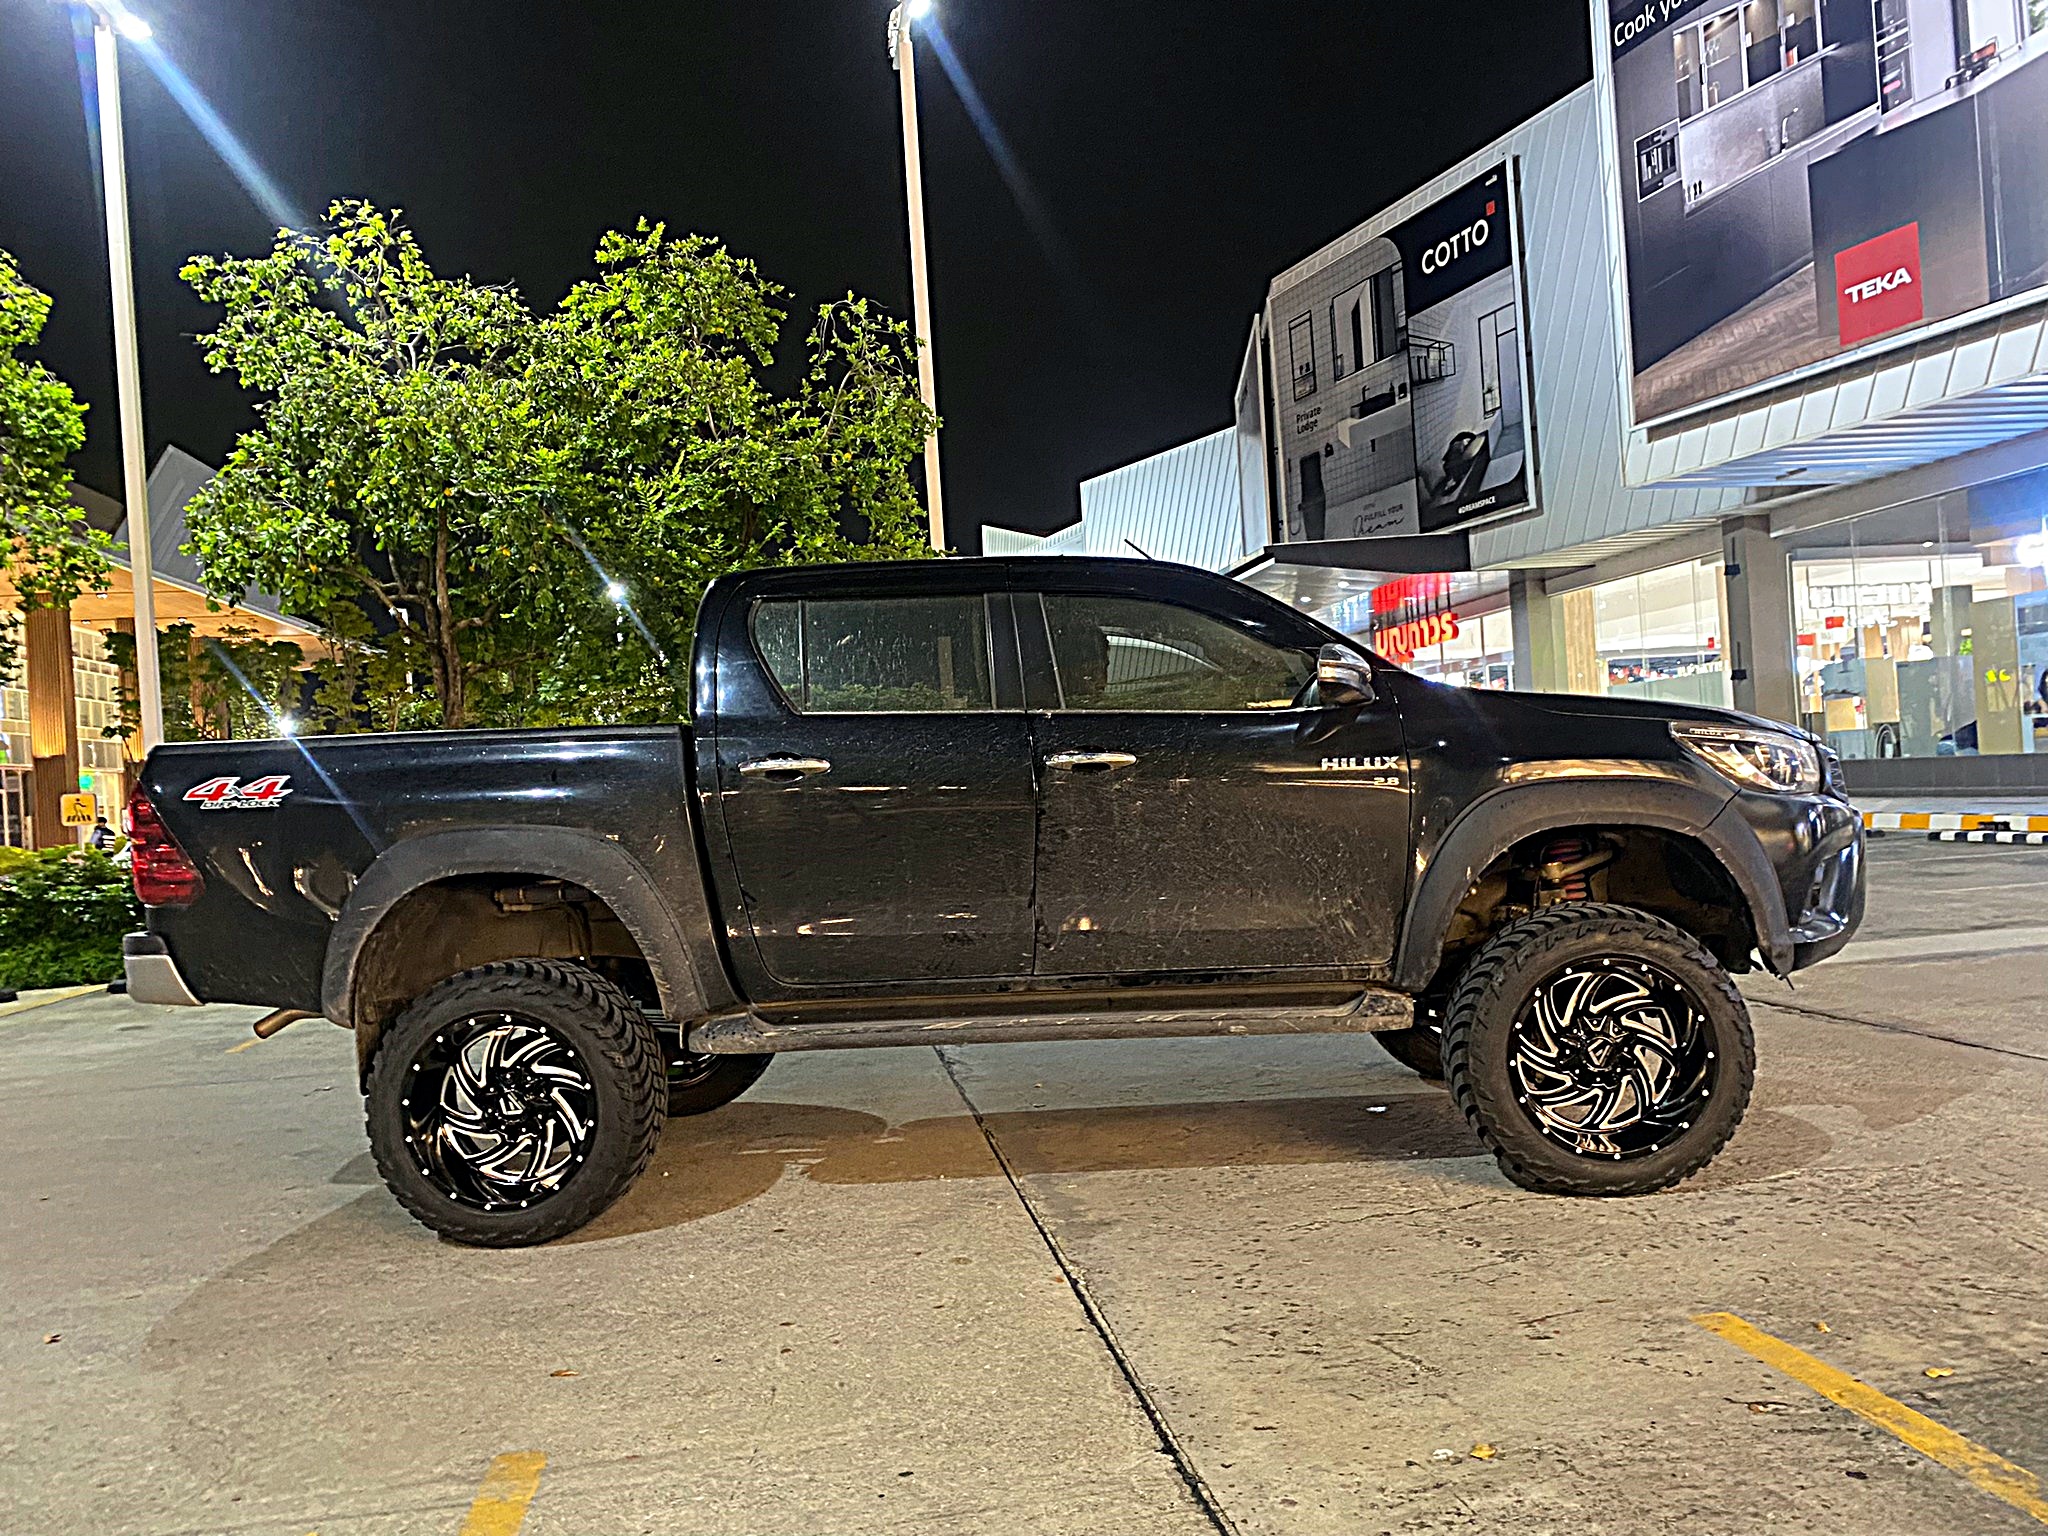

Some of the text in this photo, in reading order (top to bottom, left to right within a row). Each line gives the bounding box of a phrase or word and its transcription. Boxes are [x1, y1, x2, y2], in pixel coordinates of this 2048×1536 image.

[1614, 4, 1656, 47] Cook
[1421, 219, 1489, 274] COTTO
[1844, 267, 1912, 303] TEKA
[1296, 406, 1321, 424] Private
[1296, 419, 1318, 434] Lodge
[1321, 756, 1399, 771] HILUX
